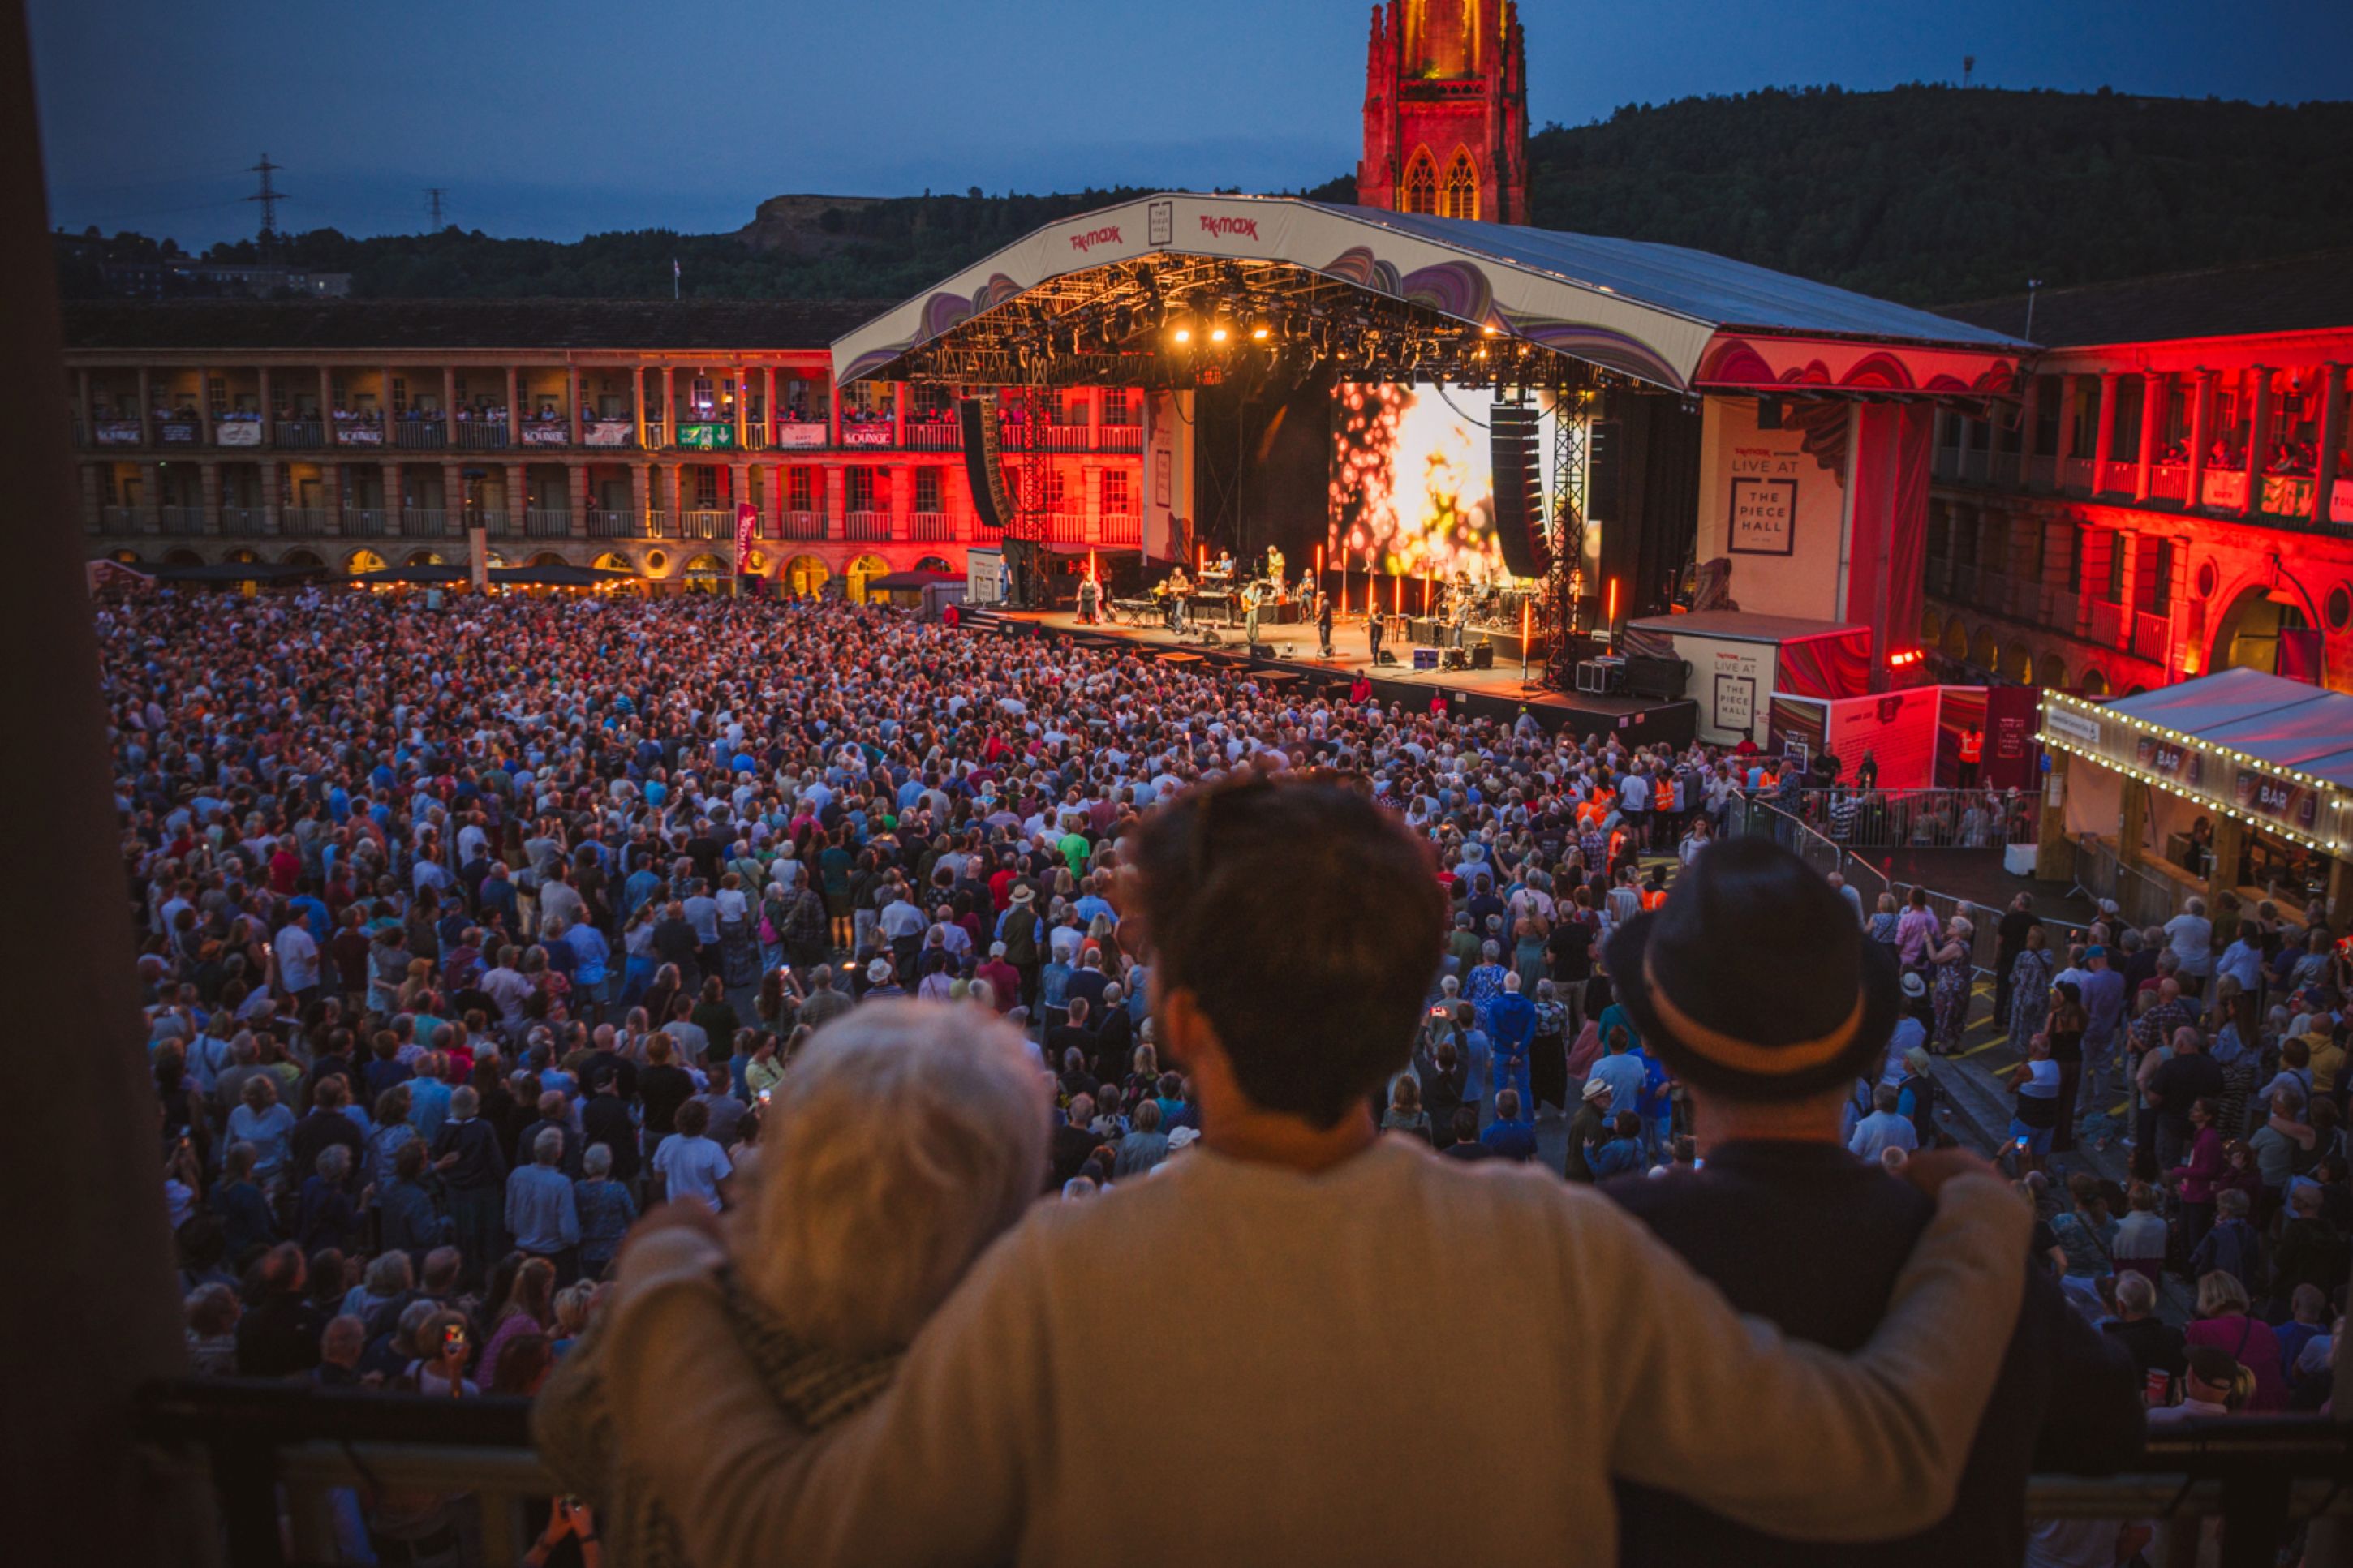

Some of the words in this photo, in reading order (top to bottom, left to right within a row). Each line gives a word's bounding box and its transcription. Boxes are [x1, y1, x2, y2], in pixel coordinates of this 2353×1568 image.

[1731, 459, 1770, 473] LIVE
[1777, 461, 1799, 474] AT
[1749, 492, 1779, 503] THE
[1740, 505, 1786, 518] PIECE
[1741, 521, 1782, 533] HALL
[1714, 661, 1739, 672] LIVE
[1742, 664, 1757, 674] AT
[1726, 685, 1744, 694] THE
[1720, 694, 1749, 706] PIECE
[1722, 705, 1747, 716] HALL
[2157, 749, 2179, 771] BAR
[2261, 785, 2287, 810] BAR
